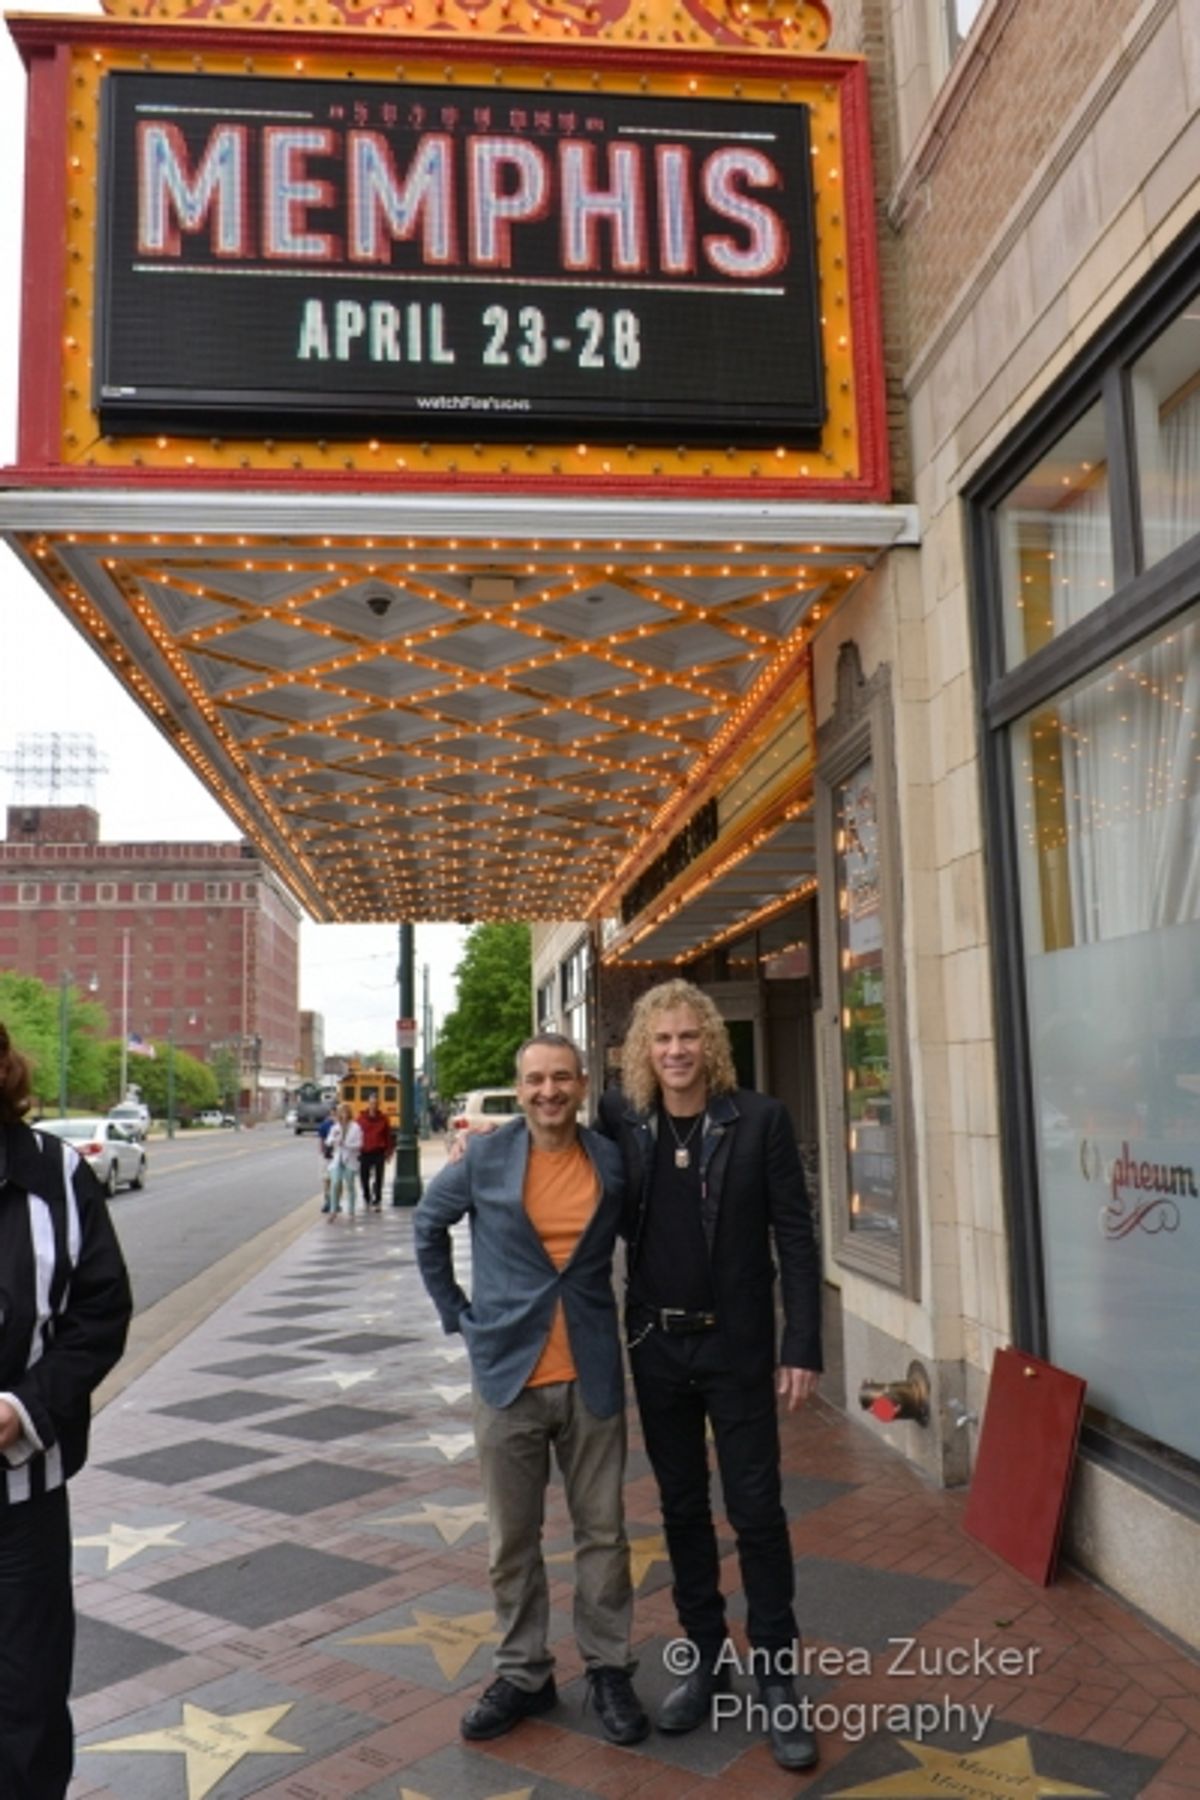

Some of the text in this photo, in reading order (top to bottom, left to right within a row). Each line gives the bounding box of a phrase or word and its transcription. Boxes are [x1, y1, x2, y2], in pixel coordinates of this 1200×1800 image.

[136, 120, 790, 279] MEMPHIS
[297, 298, 641, 370] APRIL 23-28
